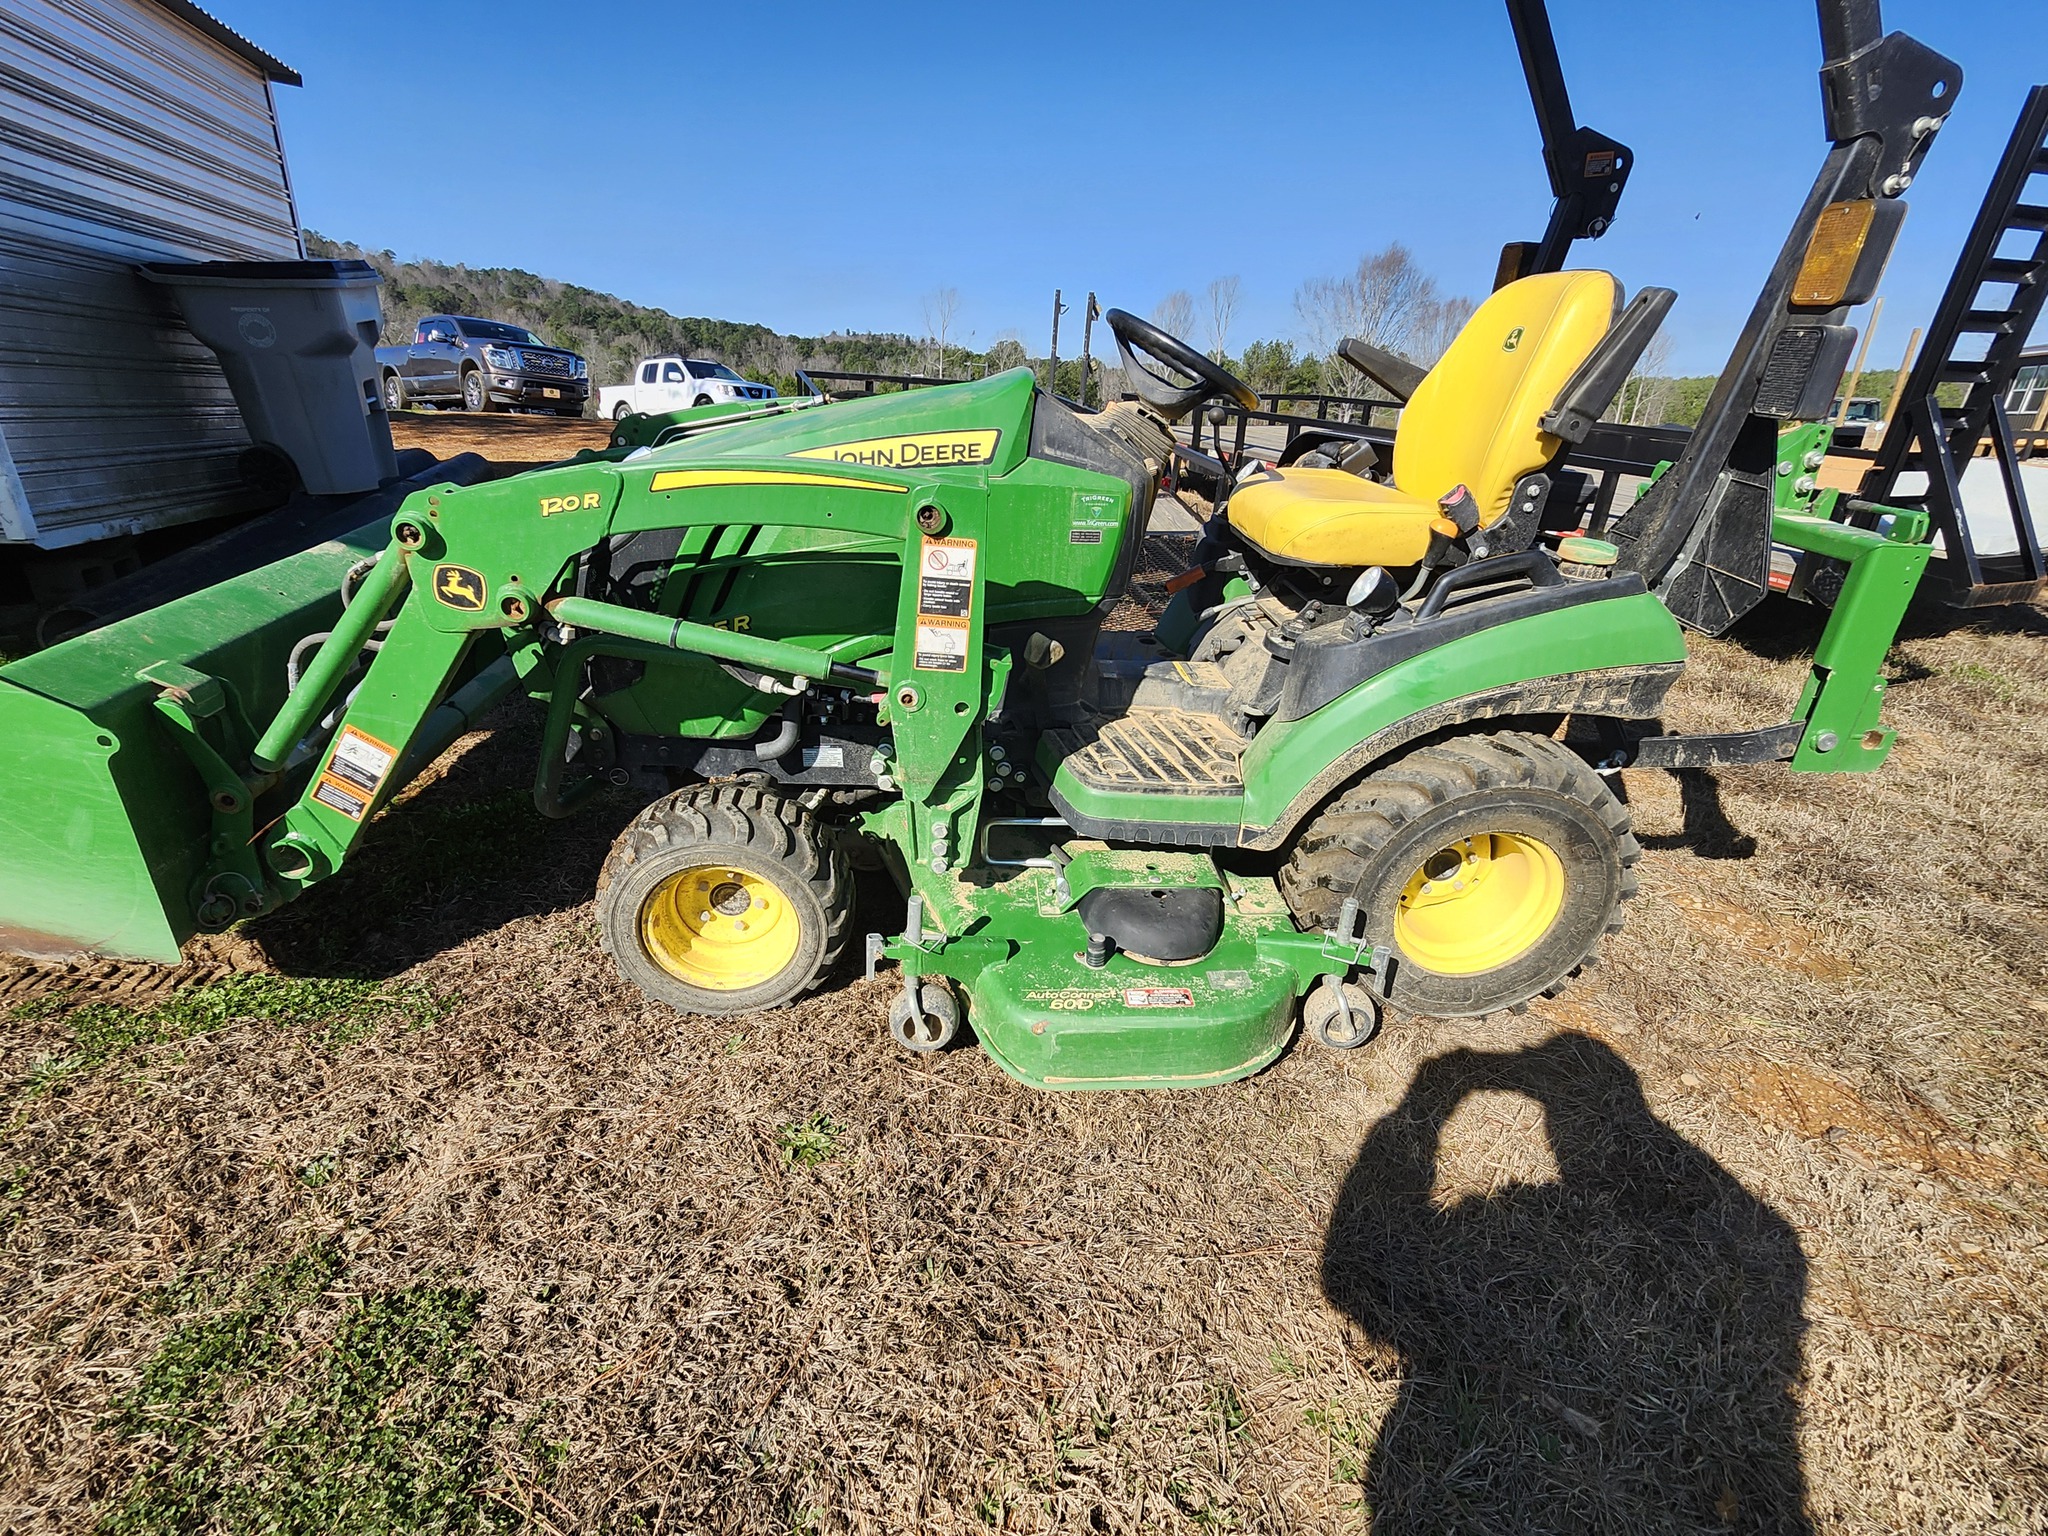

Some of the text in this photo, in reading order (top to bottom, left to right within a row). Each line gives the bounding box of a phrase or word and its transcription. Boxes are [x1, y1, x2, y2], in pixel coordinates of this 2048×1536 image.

[901, 443, 982, 463] DEERE
[932, 537, 974, 548] WARNING
[927, 618, 967, 629] WARNING
[359, 733, 391, 753] WARNING
[334, 780, 366, 800] WARNING
[1026, 990, 1117, 999] AutoConnect
[1049, 999, 1094, 1010] 60D
